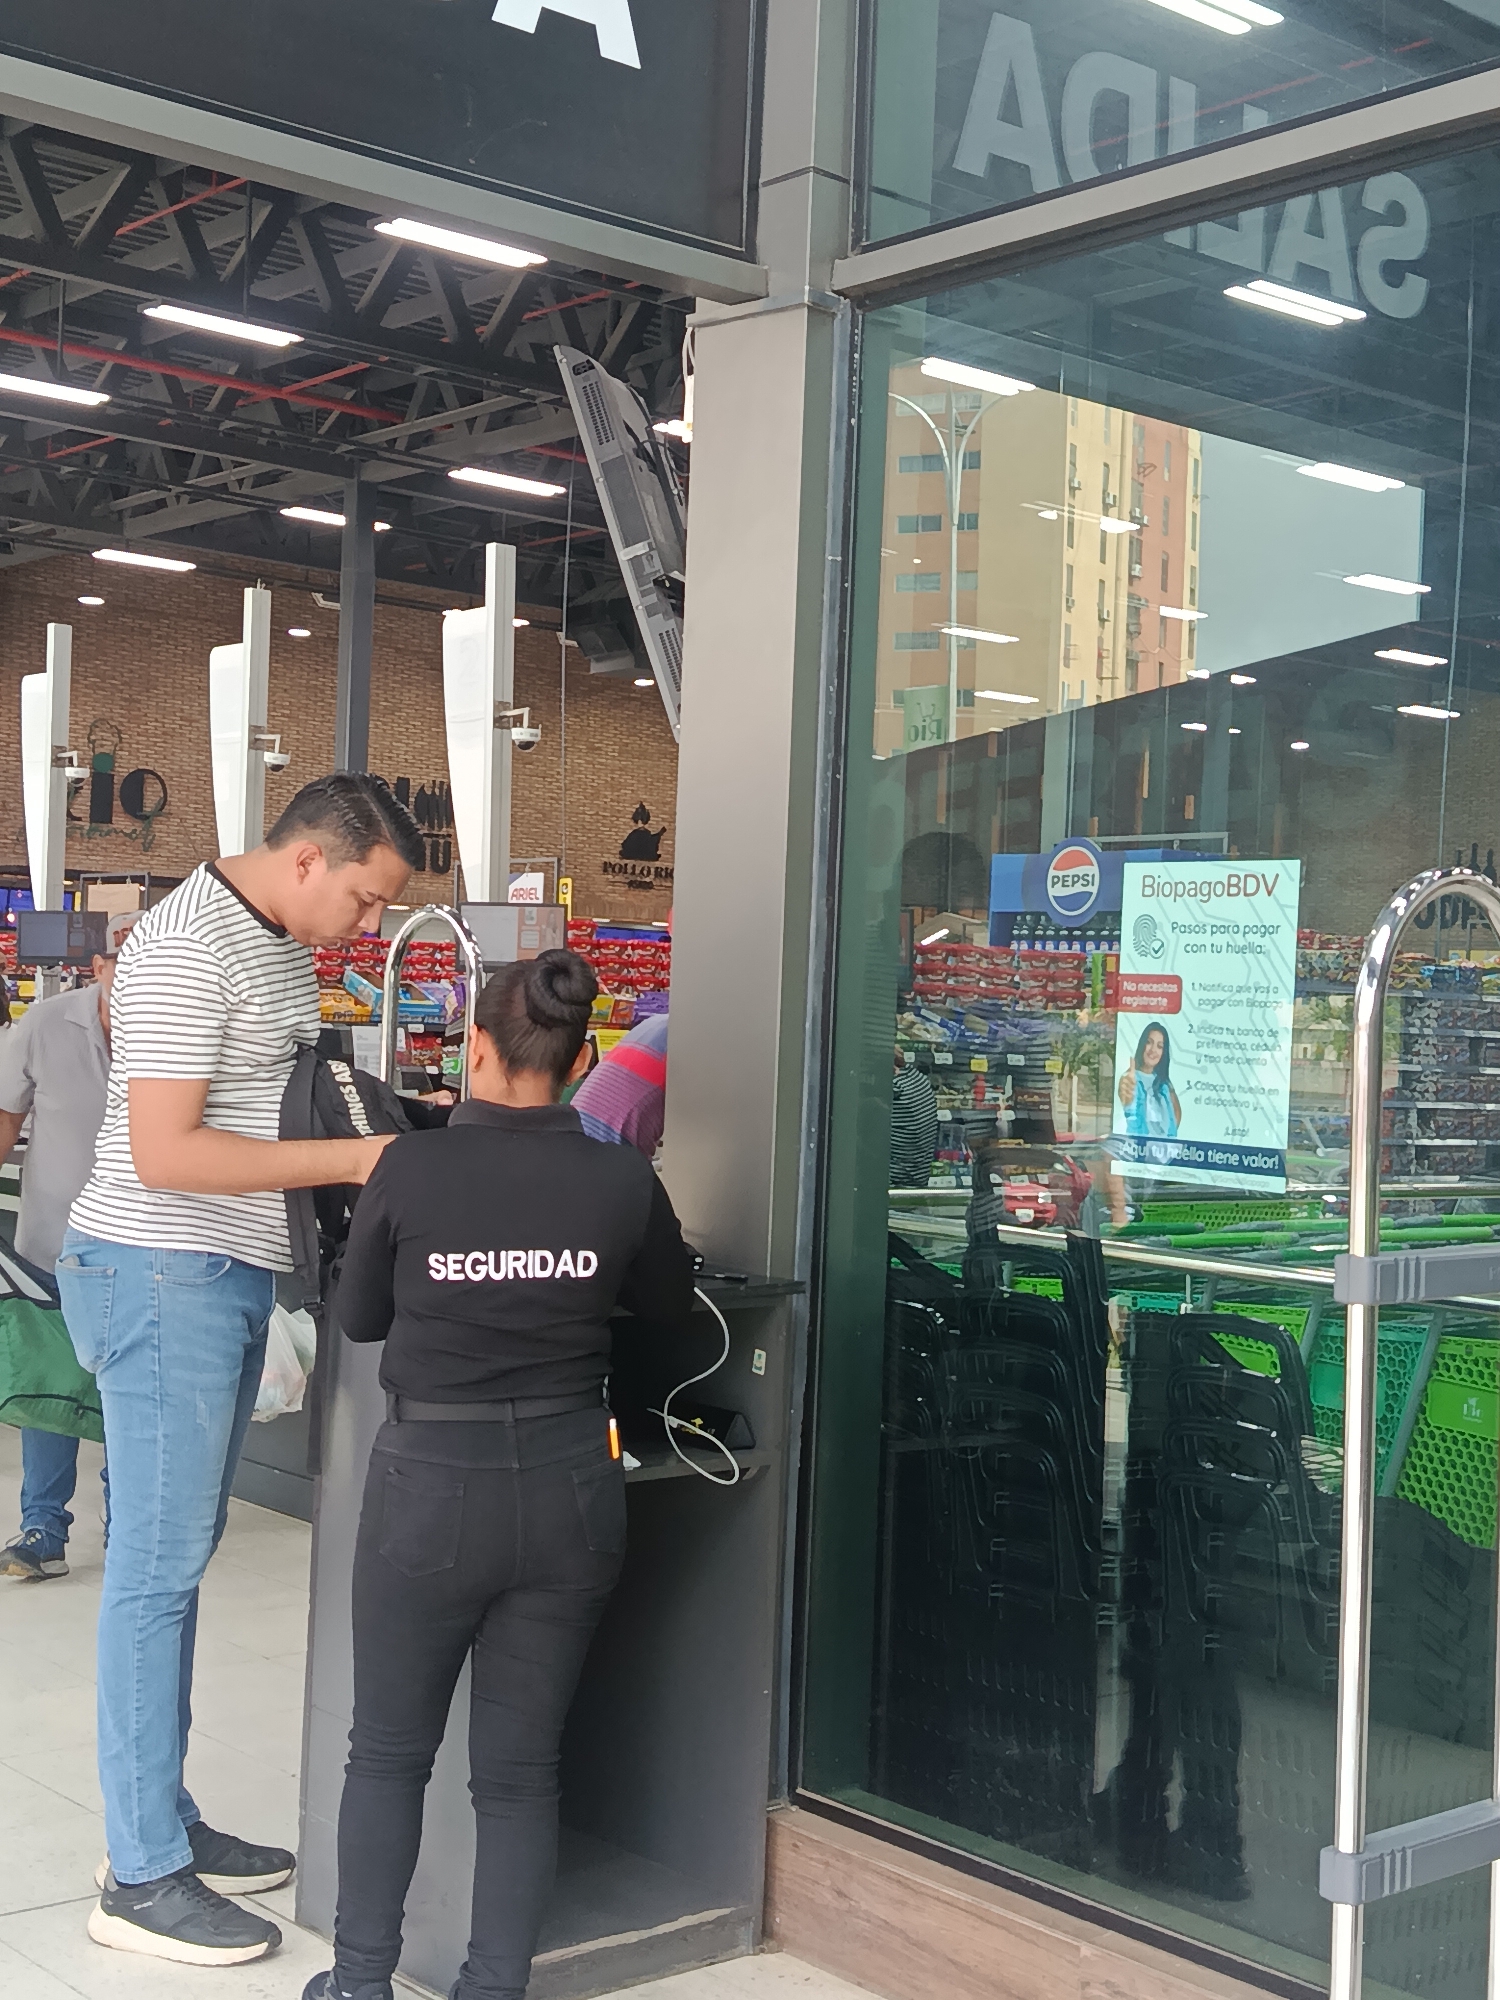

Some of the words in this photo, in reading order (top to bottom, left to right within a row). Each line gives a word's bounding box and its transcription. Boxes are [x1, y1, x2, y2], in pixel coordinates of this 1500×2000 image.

[602, 861, 651, 878] POLLO
[1051, 873, 1095, 888] PEPSI
[511, 888, 539, 900] ARIEL
[1141, 873, 1279, 903] BiopagoBDV
[1171, 921, 1207, 934] Pasos
[1210, 923, 1240, 937] para
[1243, 924, 1281, 938] pagar
[1184, 942, 1207, 954] con
[1210, 942, 1225, 954] tu
[1123, 981, 1137, 991] No
[1272, 986, 1279, 994] a
[1198, 998, 1225, 1009] pagar
[1227, 999, 1244, 1007] con
[1267, 1028, 1279, 1038] de
[1207, 1149, 1240, 1166] tiene
[1242, 1152, 1279, 1169] valor!
[428, 1249, 598, 1281] SEGURIDAD
